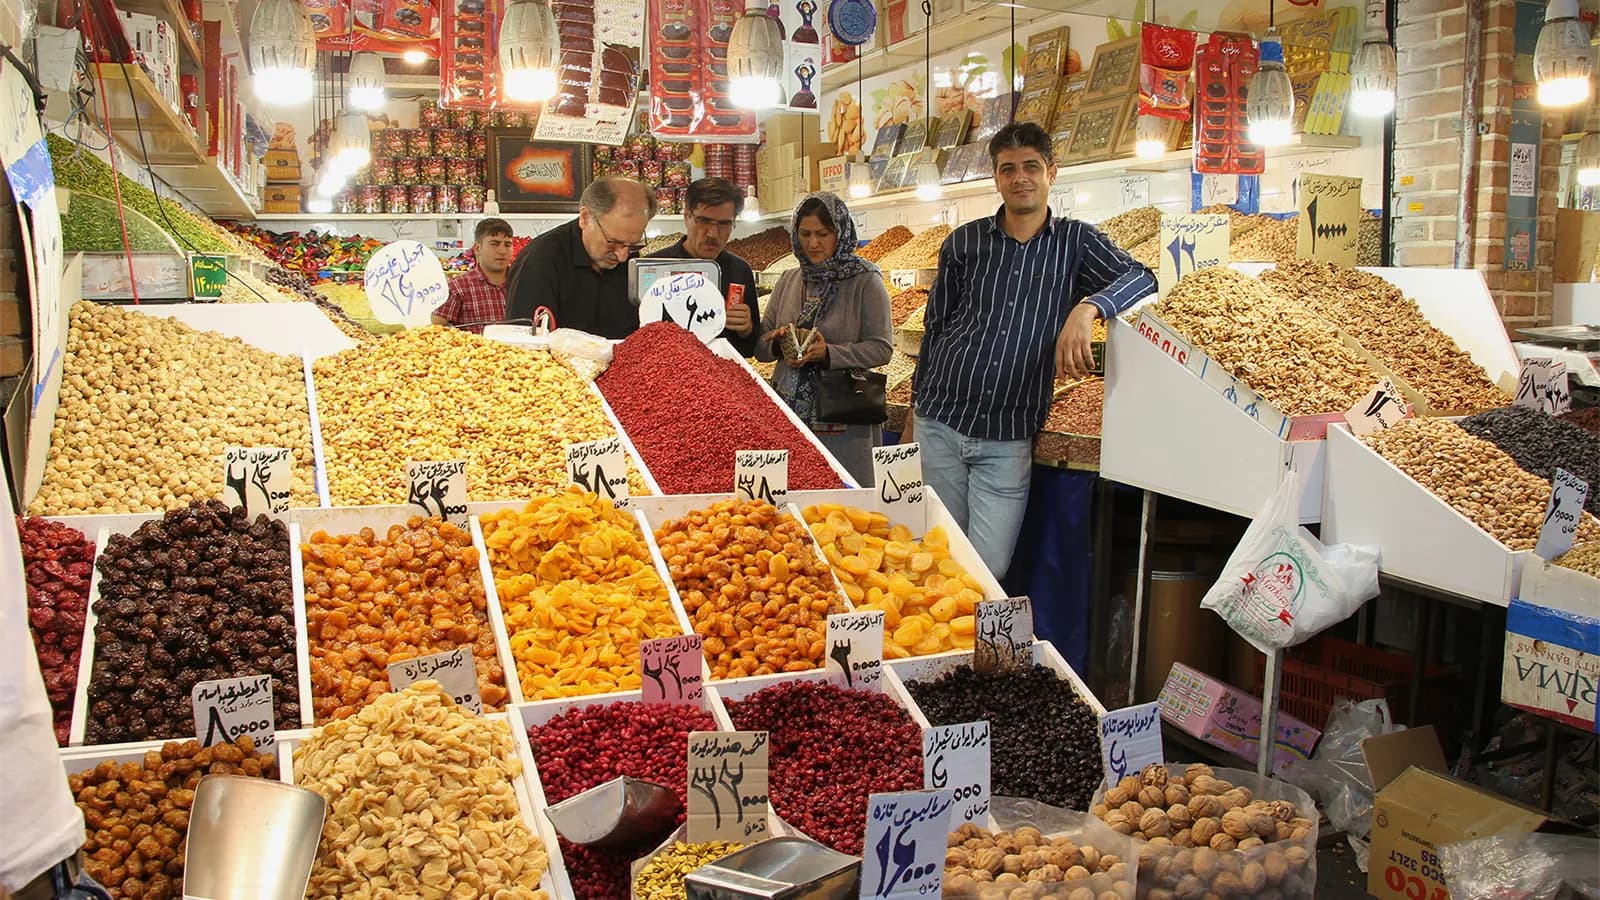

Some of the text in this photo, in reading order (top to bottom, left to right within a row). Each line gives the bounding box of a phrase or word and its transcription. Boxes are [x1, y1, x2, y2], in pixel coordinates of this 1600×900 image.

[538, 130, 624, 144] Saffron Saffron Saffron
[227, 448, 247, 464] تازه
[409, 463, 429, 480] تازه
[977, 605, 993, 620] تازه
[830, 618, 849, 631] تازه
[643, 642, 661, 656] تازه
[405, 659, 428, 680] تازه
[1513, 655, 1598, 705] RIMA
[1102, 719, 1118, 738] تازه
[926, 728, 954, 757] شیراز
[873, 802, 898, 822] تازه
[964, 799, 989, 820] تومان
[1389, 850, 1418, 872] 32LT
